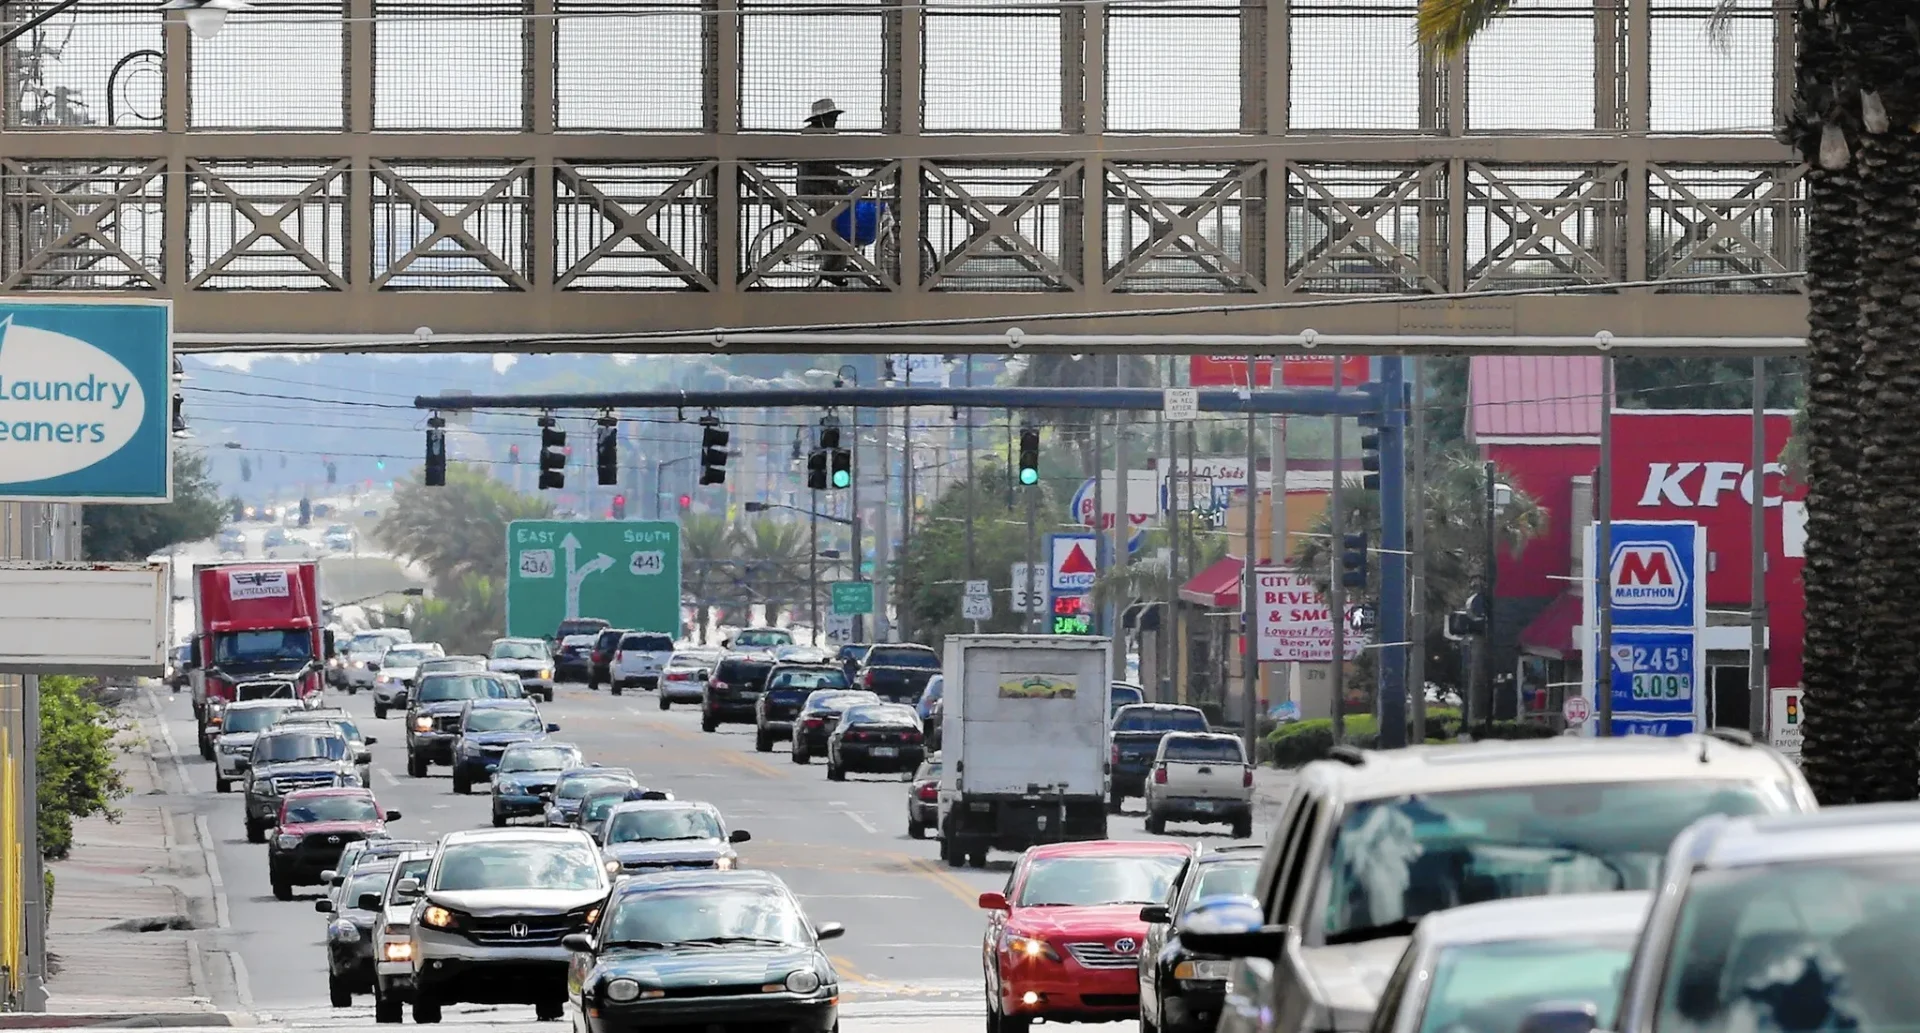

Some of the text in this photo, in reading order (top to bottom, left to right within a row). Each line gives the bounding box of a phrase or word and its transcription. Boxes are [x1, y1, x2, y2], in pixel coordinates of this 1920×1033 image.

[0, 374, 130, 409] Laundry
[1637, 462, 1787, 507] KFC
[516, 528, 555, 543] EAST
[623, 529, 670, 543] SOUTH
[521, 560, 548, 573] 436
[633, 555, 660, 569] 441
[1618, 552, 1673, 585] M
[1059, 575, 1097, 585] CITGO
[1261, 577, 1290, 587] CITY
[969, 583, 985, 592] JCT
[1614, 588, 1675, 598] MARATHON
[1016, 591, 1044, 607] 35
[1269, 610, 1282, 622] &
[827, 628, 850, 641] 45
[1264, 626, 1308, 637] Lowest
[1280, 639, 1314, 648] Beer,
